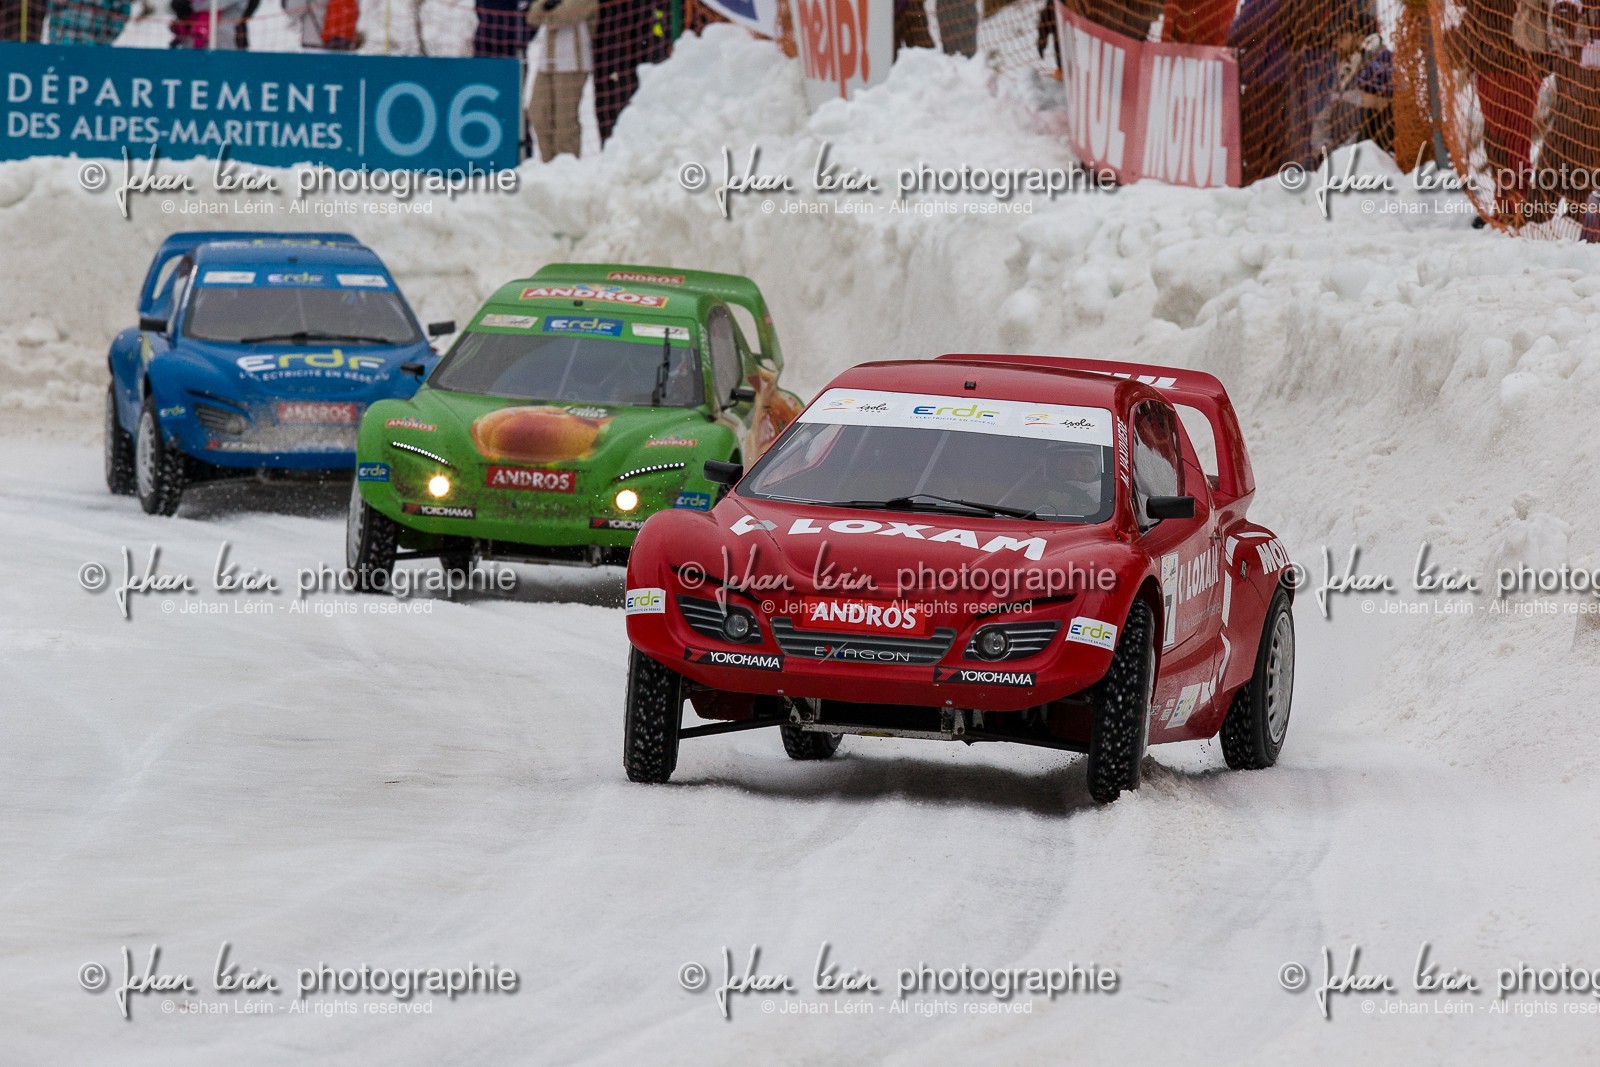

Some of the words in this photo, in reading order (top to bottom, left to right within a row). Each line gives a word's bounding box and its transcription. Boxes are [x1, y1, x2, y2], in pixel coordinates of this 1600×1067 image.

[8, 66, 343, 114] DÉPARTEMENT
[8, 111, 60, 140] DES
[70, 115, 343, 149] ALPES-MARITIMES
[375, 82, 503, 158] 06
[1142, 55, 1227, 187] MOTUL
[611, 273, 681, 284] ANDROS
[527, 288, 659, 307] ANDROS
[492, 470, 570, 490] ANDROS
[421, 506, 474, 518] YOKOHAMA
[788, 519, 1047, 561] LOXAM
[811, 602, 917, 629] ANDROS
[710, 652, 780, 668] YOKOHAMA
[960, 670, 1033, 685] YOKOHAMA
